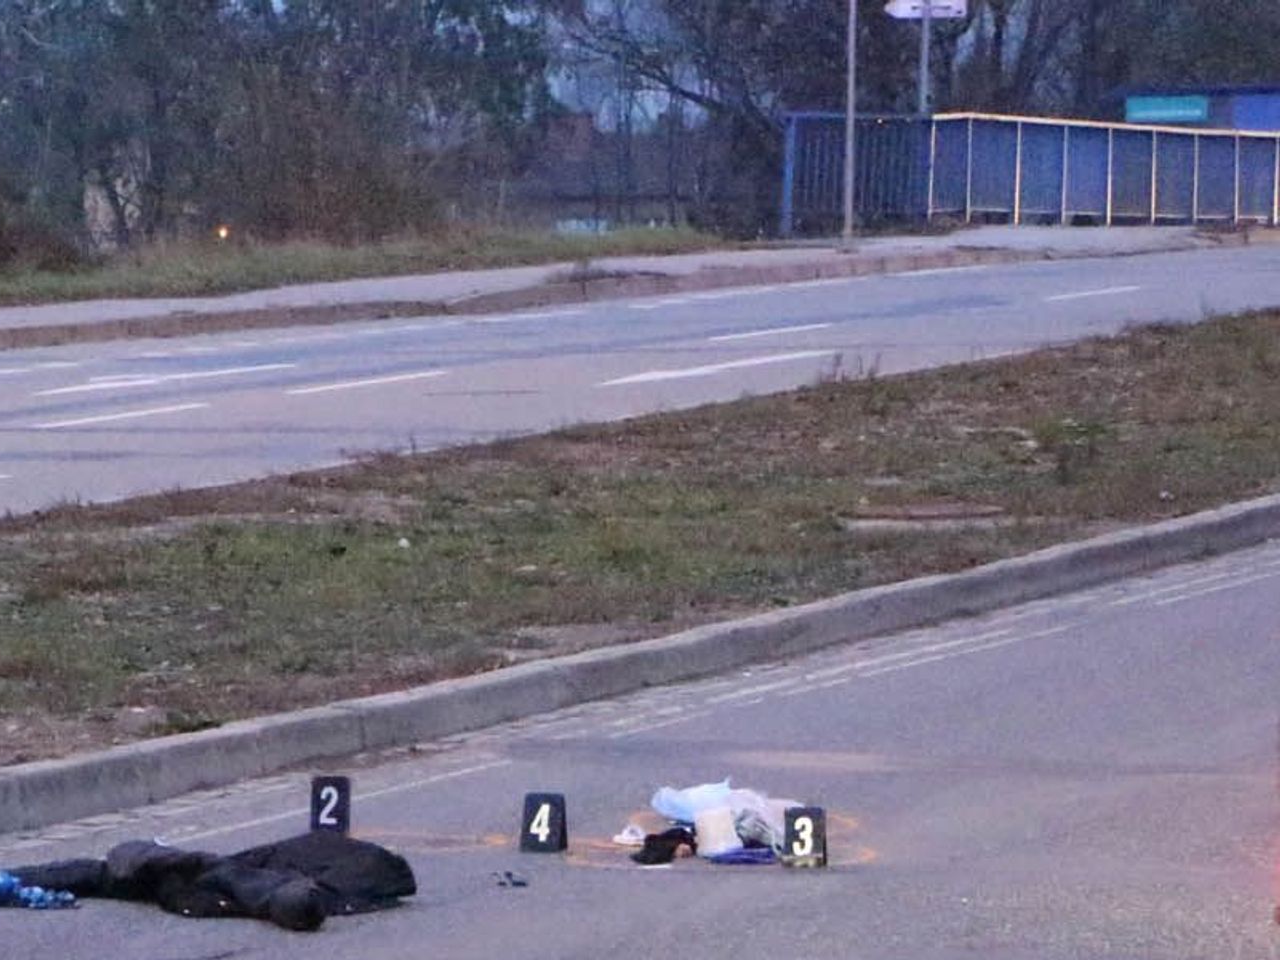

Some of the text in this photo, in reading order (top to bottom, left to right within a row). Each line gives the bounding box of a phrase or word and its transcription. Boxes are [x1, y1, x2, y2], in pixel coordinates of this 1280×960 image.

[319, 786, 339, 825] 2
[529, 803, 551, 842] 4
[793, 816, 813, 856] 3
